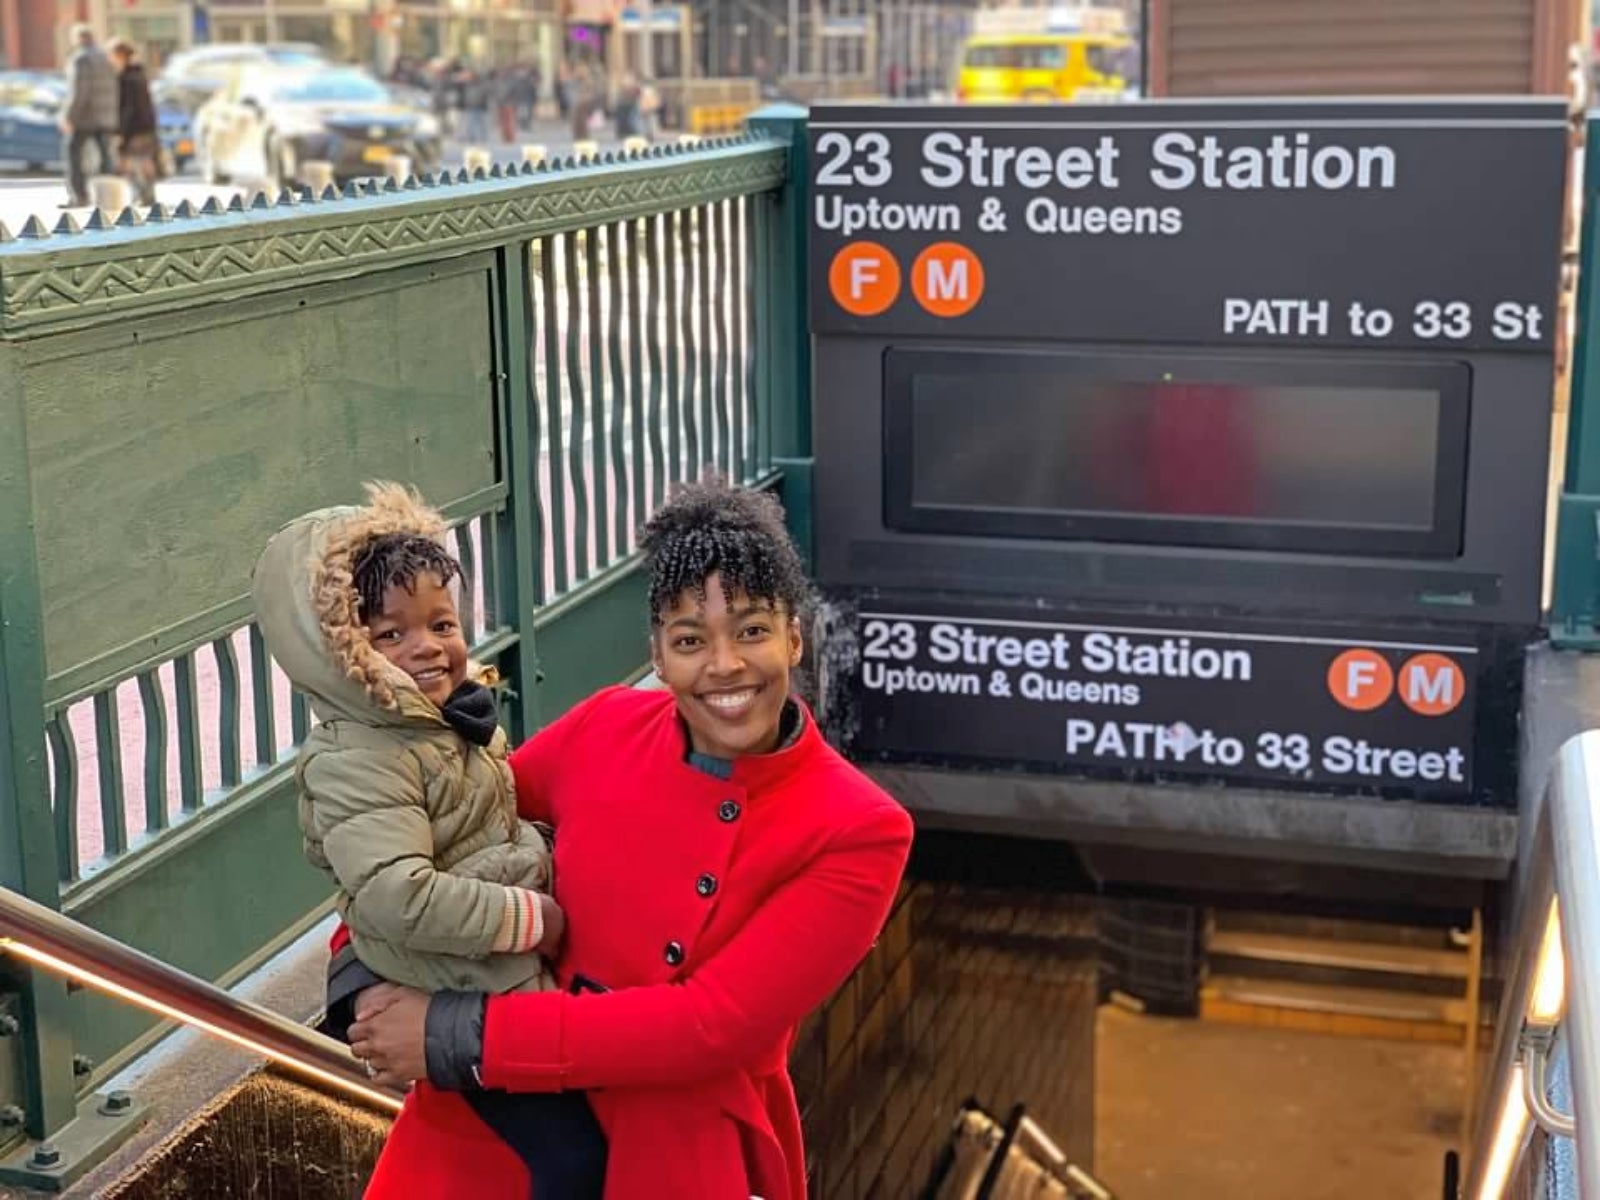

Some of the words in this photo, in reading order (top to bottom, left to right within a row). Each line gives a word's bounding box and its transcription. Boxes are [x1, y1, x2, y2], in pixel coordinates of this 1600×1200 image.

[816, 133, 893, 187] 23
[920, 133, 1119, 190] Street
[1150, 133, 1396, 191] Station
[816, 195, 961, 236] Uptown
[978, 197, 1007, 232] &
[1025, 197, 1182, 235] Queens
[851, 258, 880, 299] F
[927, 259, 968, 300] M
[1223, 298, 1329, 336] PATH
[1348, 302, 1393, 337] to
[1413, 301, 1472, 339] 33
[1492, 302, 1542, 340] St
[863, 622, 917, 660] 23
[929, 624, 1071, 669] Street
[1081, 632, 1252, 682] Station
[863, 663, 981, 695] Uptown
[988, 671, 1012, 697] &
[1019, 674, 1140, 706] Queens
[1346, 659, 1378, 699] F
[1407, 664, 1454, 705] M
[1066, 718, 1186, 761] PATH
[1201, 730, 1244, 765] to
[1256, 732, 1311, 771] 33
[1322, 736, 1464, 782] Street
